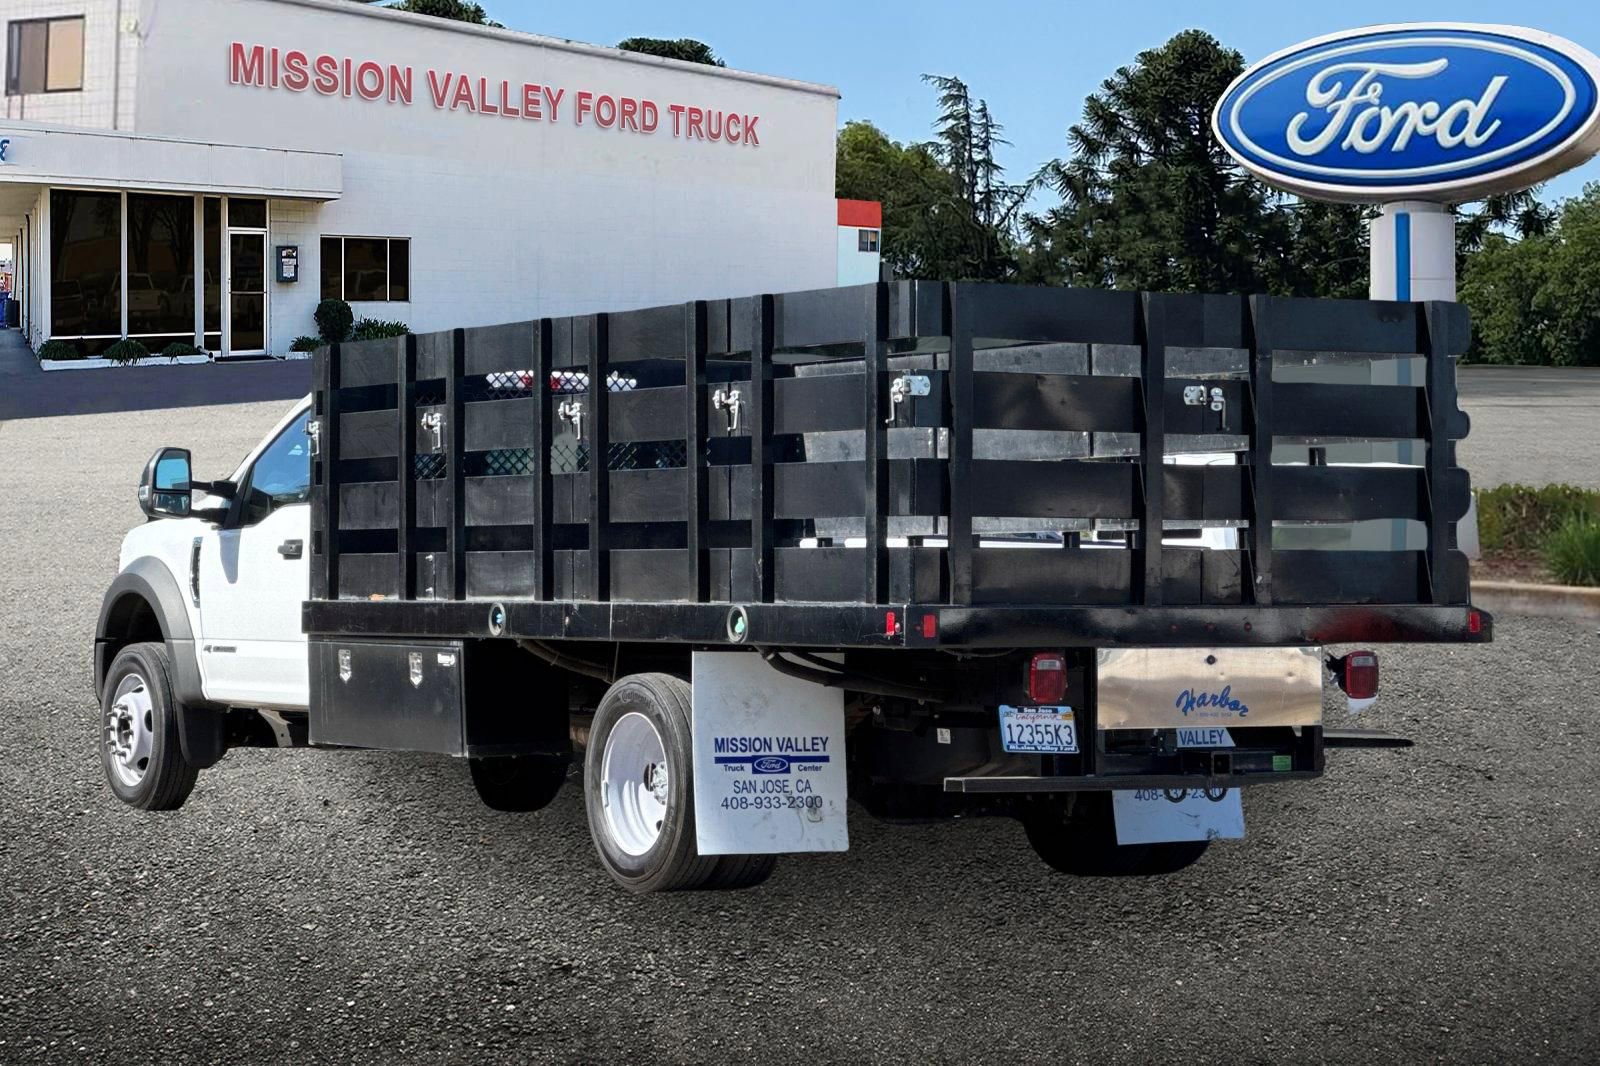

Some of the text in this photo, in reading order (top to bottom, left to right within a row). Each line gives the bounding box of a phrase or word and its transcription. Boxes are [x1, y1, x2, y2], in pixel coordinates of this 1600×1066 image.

[229, 41, 761, 147] MISSION VALLEY FORD TRUCK
[1286, 58, 1509, 156] Ford
[1175, 685, 1249, 717] Harbor
[1006, 723, 1074, 746] 12355K3
[1179, 729, 1225, 746] VALLEY
[714, 736, 829, 753] MISSION VALLEY
[724, 759, 822, 772] Truck Ford Center
[733, 779, 812, 795] SAN JOSE, CA
[721, 795, 823, 810] 408-933-2300
